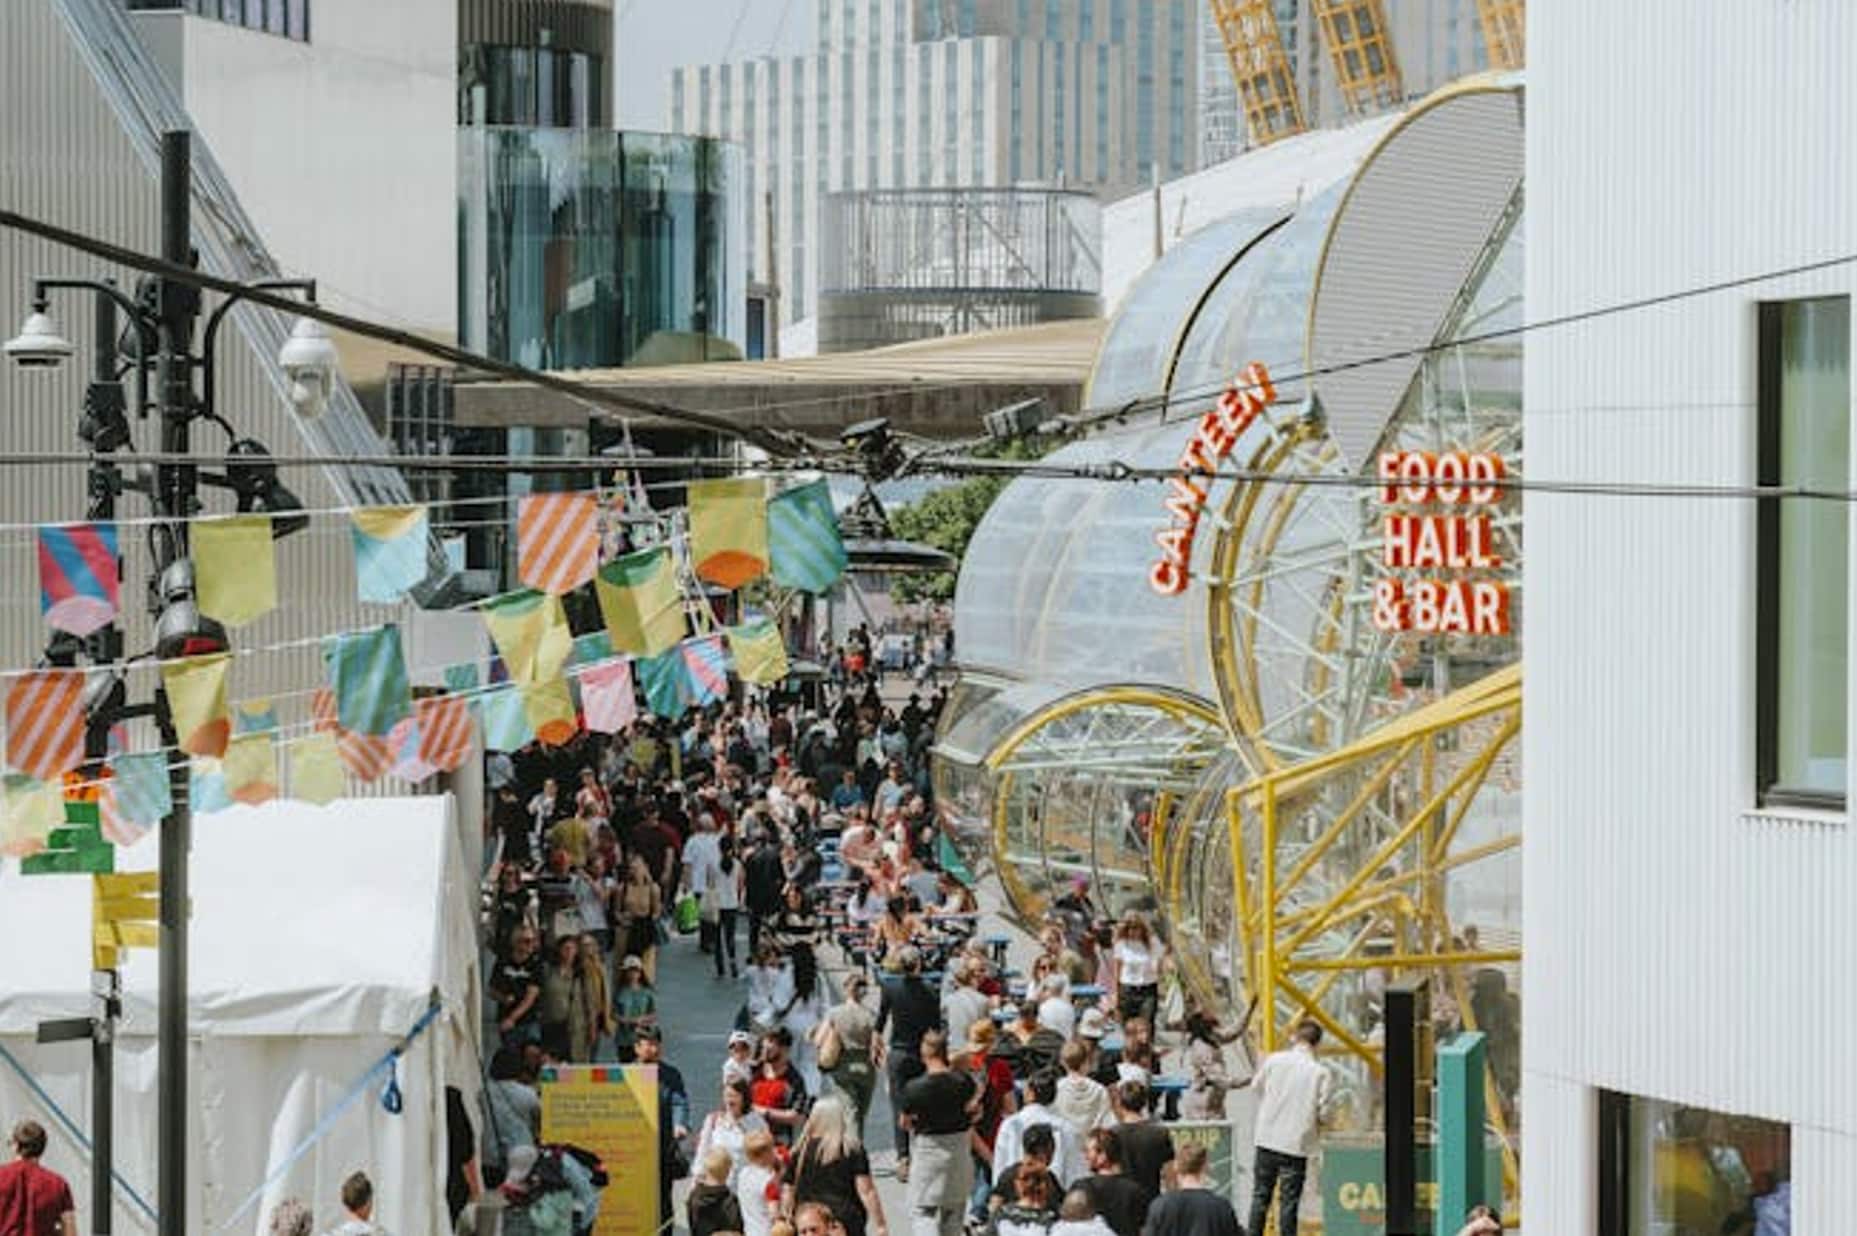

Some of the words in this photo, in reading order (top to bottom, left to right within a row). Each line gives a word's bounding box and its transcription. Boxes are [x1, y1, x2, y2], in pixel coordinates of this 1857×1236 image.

[1151, 362, 1276, 595] CANTEEN
[1379, 452, 1503, 504] FOOD
[1384, 515, 1501, 568] HALL
